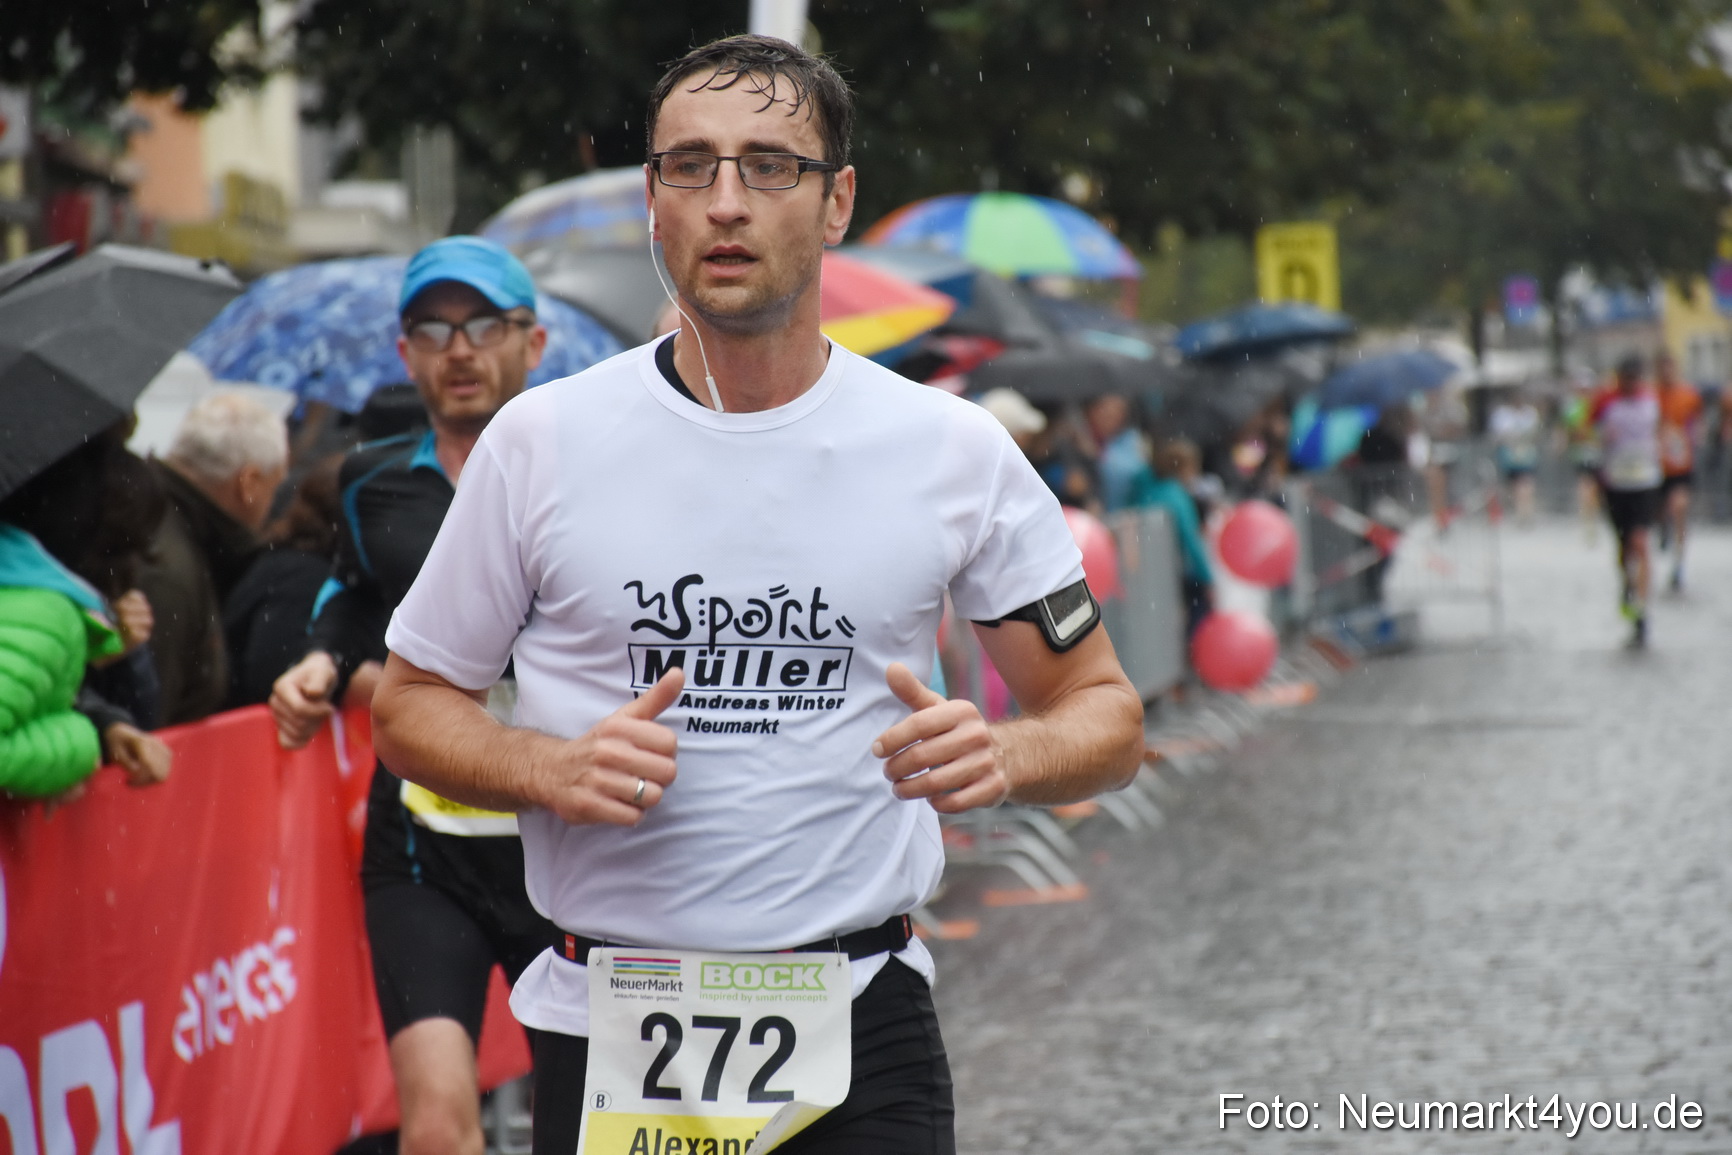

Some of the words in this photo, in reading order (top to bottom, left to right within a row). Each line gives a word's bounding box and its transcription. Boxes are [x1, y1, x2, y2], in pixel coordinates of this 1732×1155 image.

[629, 574, 832, 655] Sport
[643, 649, 842, 687] Müller
[678, 693, 770, 711] Andreas
[777, 695, 845, 711] Winter
[686, 716, 780, 735] Neumarkt
[610, 977, 684, 993] NeuerMarkt
[700, 962, 826, 991] BOCK
[699, 991, 739, 1002] inspired
[741, 992, 753, 1003] by
[755, 994, 783, 1002] smart
[785, 994, 829, 1003] concepts
[641, 1012, 796, 1103] 272
[595, 1094, 606, 1109] B
